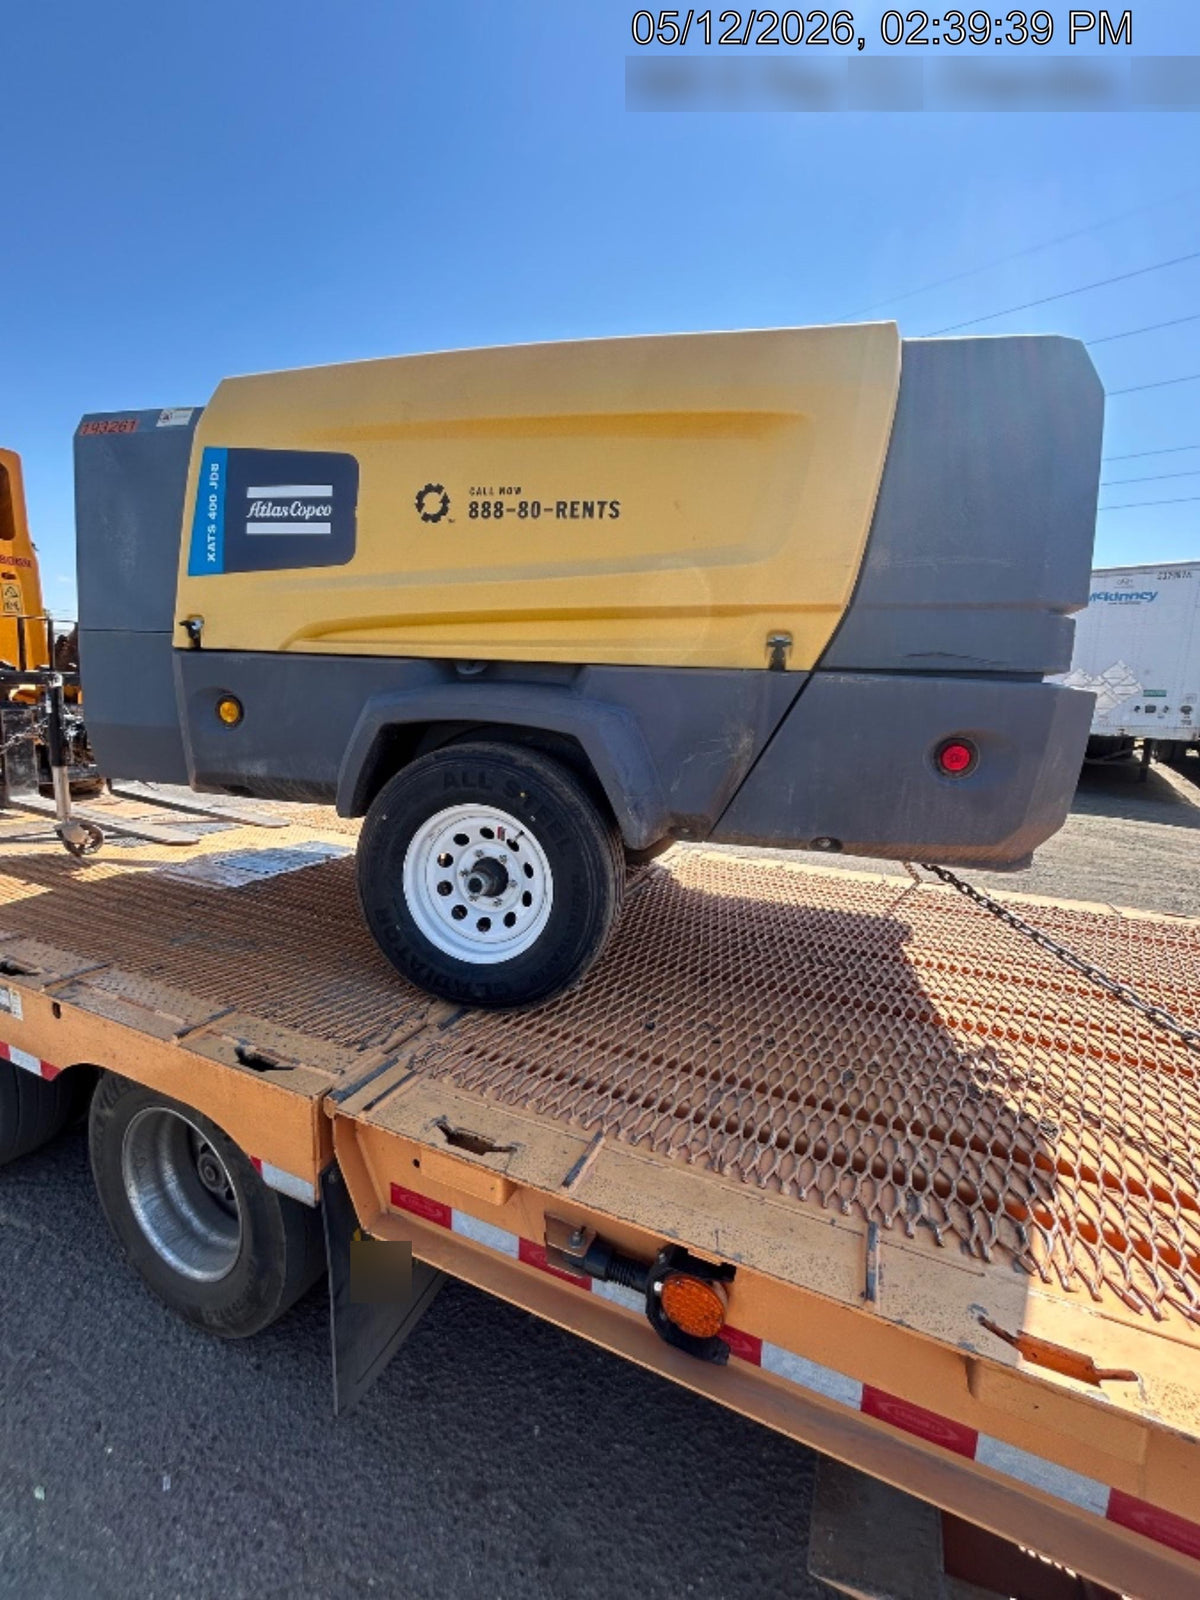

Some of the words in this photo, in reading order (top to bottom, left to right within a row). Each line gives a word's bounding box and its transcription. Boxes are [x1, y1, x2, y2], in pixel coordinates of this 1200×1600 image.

[469, 486, 494, 496] CALL
[499, 486, 522, 495] NOW
[208, 493, 218, 520] 400
[246, 501, 288, 518] Atlas
[290, 501, 332, 520] Copco
[468, 501, 621, 519] 888-80-RENTS
[207, 524, 217, 562] XATS
[443, 770, 494, 790] ALL
